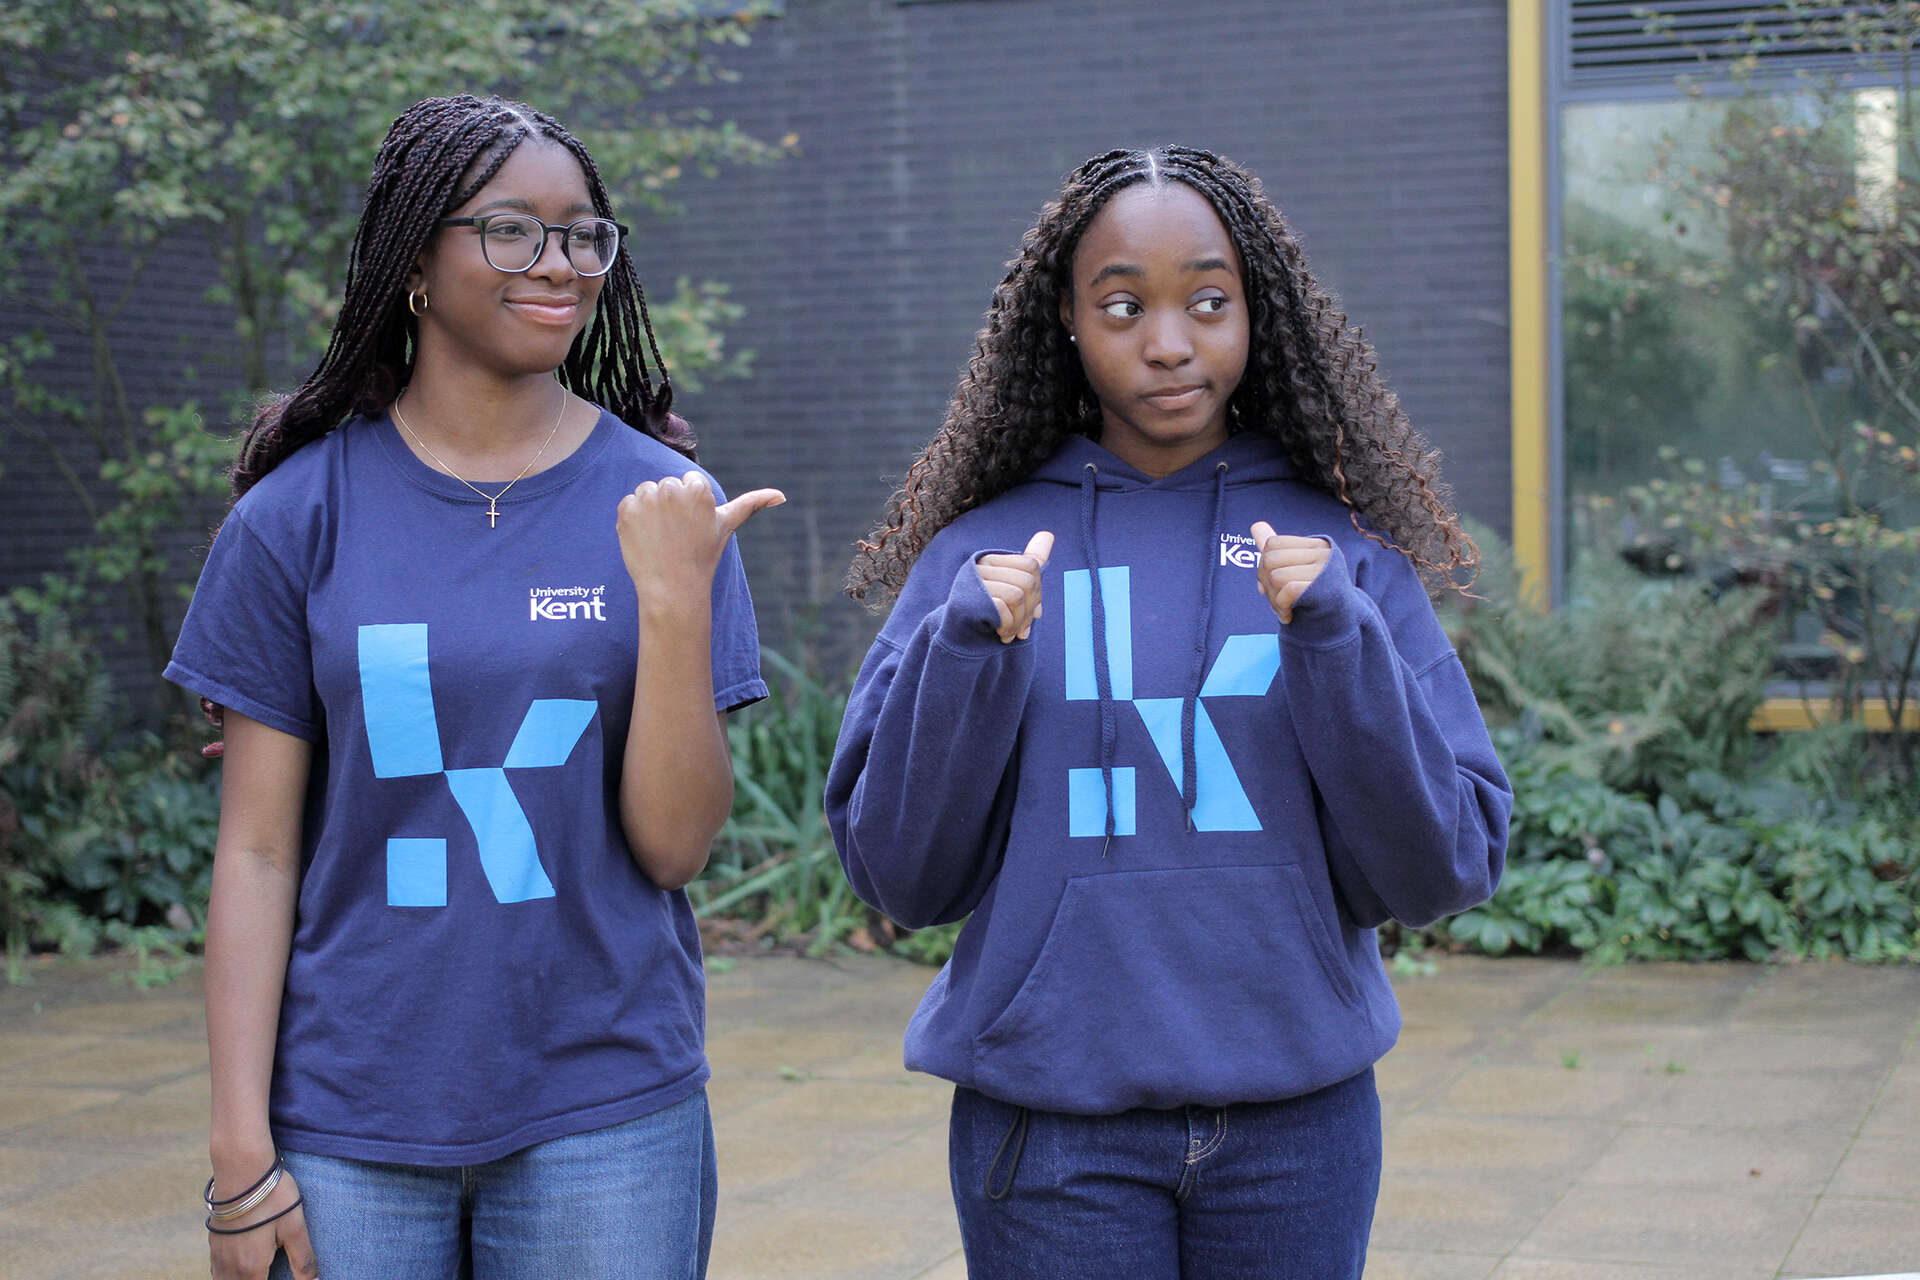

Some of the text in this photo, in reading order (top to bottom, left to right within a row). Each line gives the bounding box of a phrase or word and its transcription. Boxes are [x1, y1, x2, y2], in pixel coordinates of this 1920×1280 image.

[1220, 533, 1256, 545] Univer
[1220, 543, 1262, 568] Ke
[530, 585, 605, 598] University of
[530, 596, 606, 621] Kent
